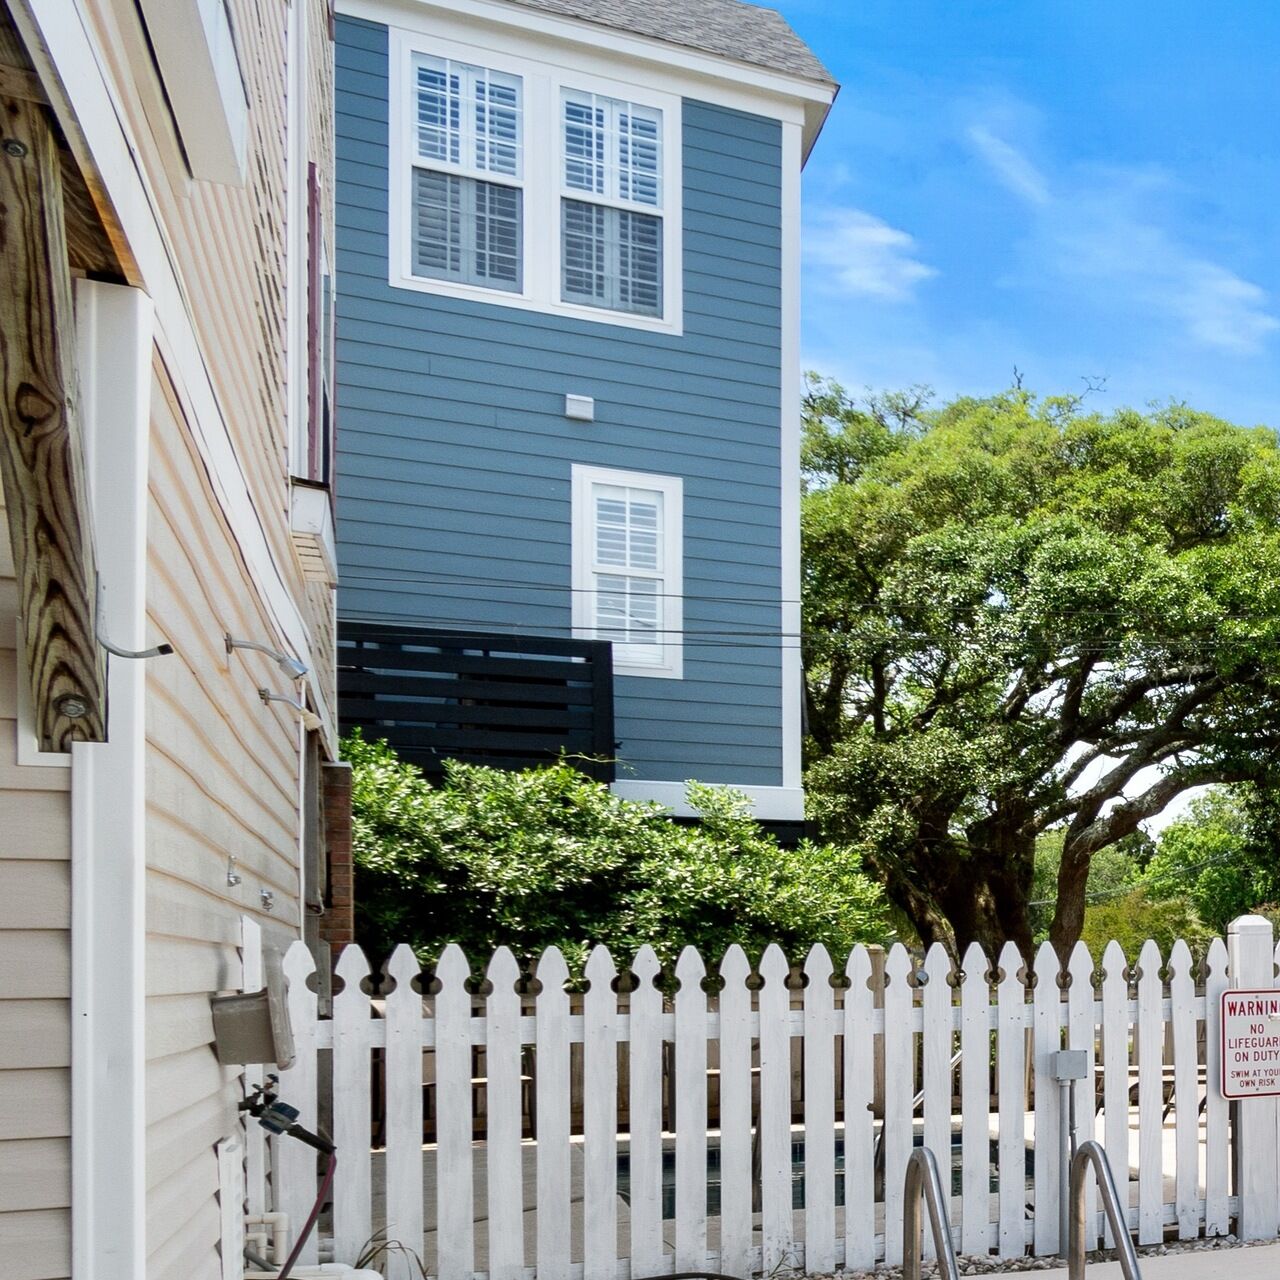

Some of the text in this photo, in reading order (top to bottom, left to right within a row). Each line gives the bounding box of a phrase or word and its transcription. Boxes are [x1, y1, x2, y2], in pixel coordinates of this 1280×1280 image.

[1250, 1024, 1264, 1034] NO
[1235, 1050, 1280, 1062] ON DUTY
[1231, 1070, 1249, 1078] SWIM
[1252, 1069, 1261, 1077] AT
[1240, 1078, 1275, 1088] OWN RISK
